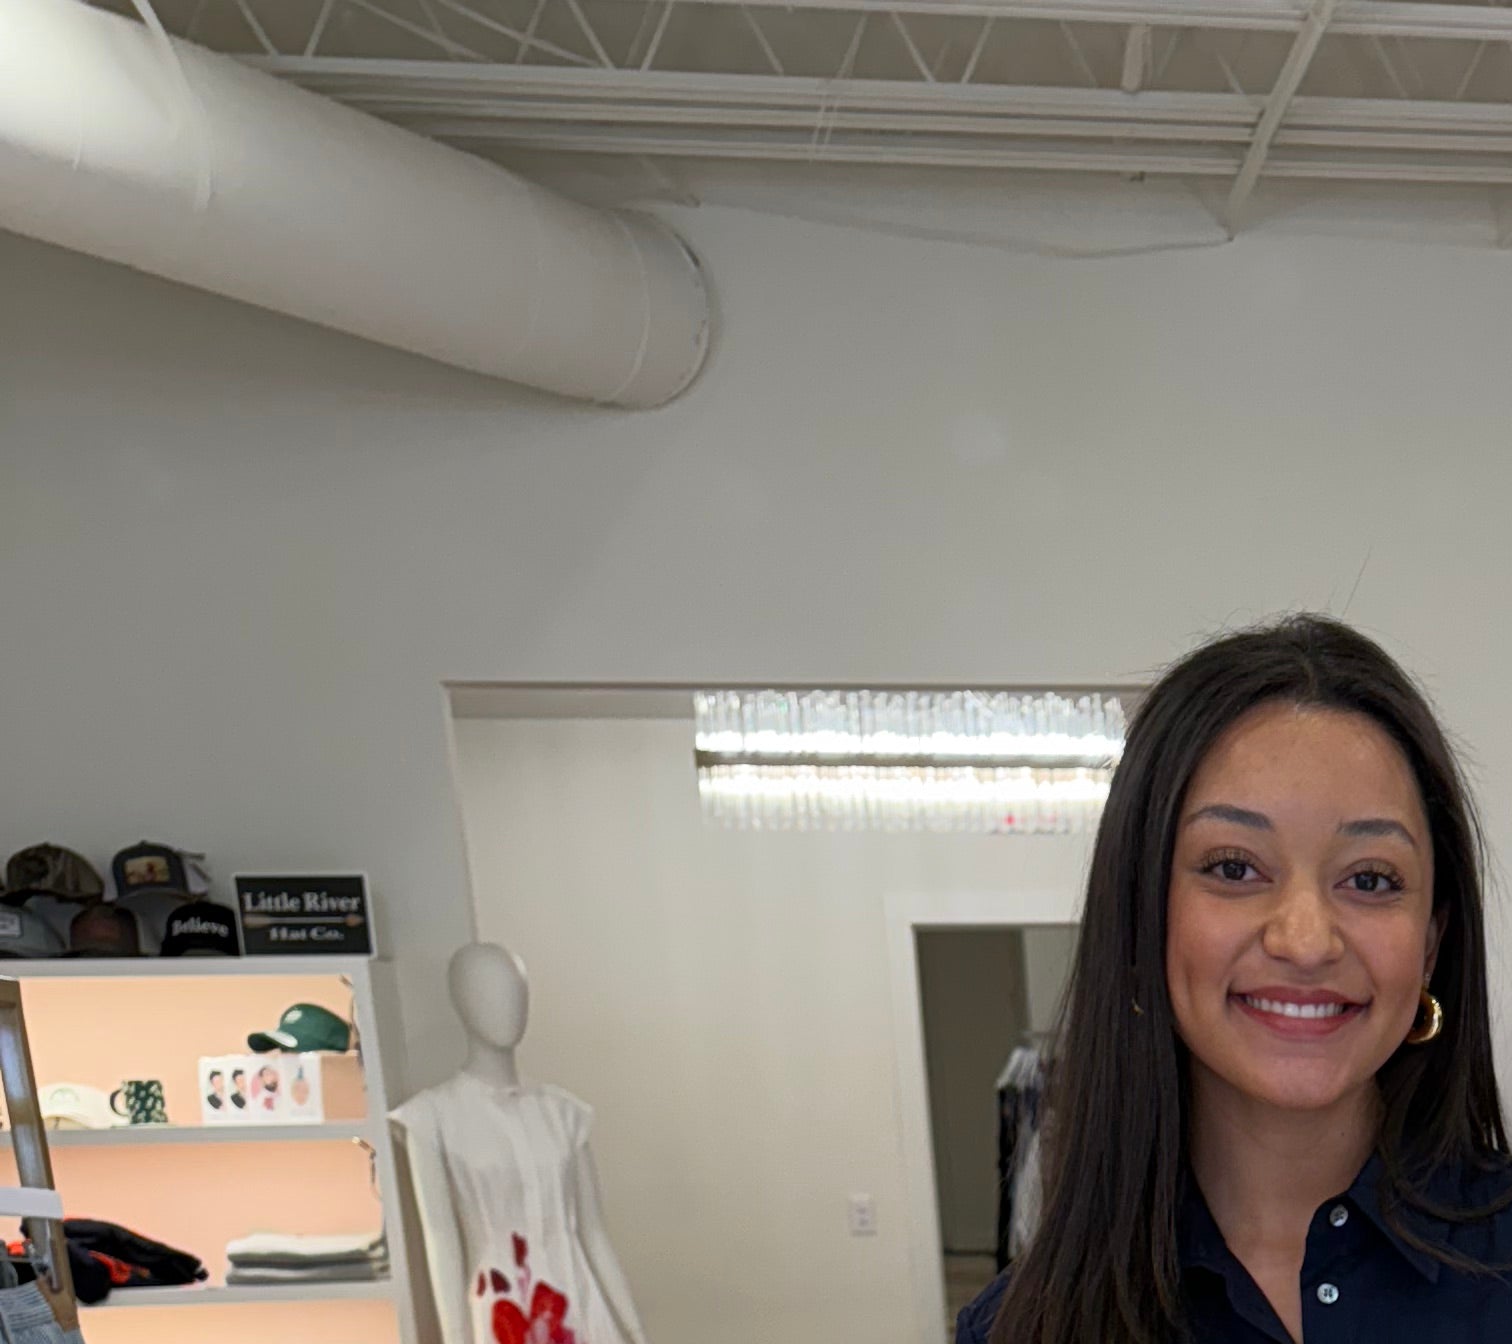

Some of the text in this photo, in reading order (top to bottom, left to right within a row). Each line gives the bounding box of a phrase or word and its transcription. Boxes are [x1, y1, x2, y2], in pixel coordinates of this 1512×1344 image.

[243, 891, 361, 913] Little River
[171, 915, 230, 938] Believe
[268, 925, 345, 942] Hat Co.
